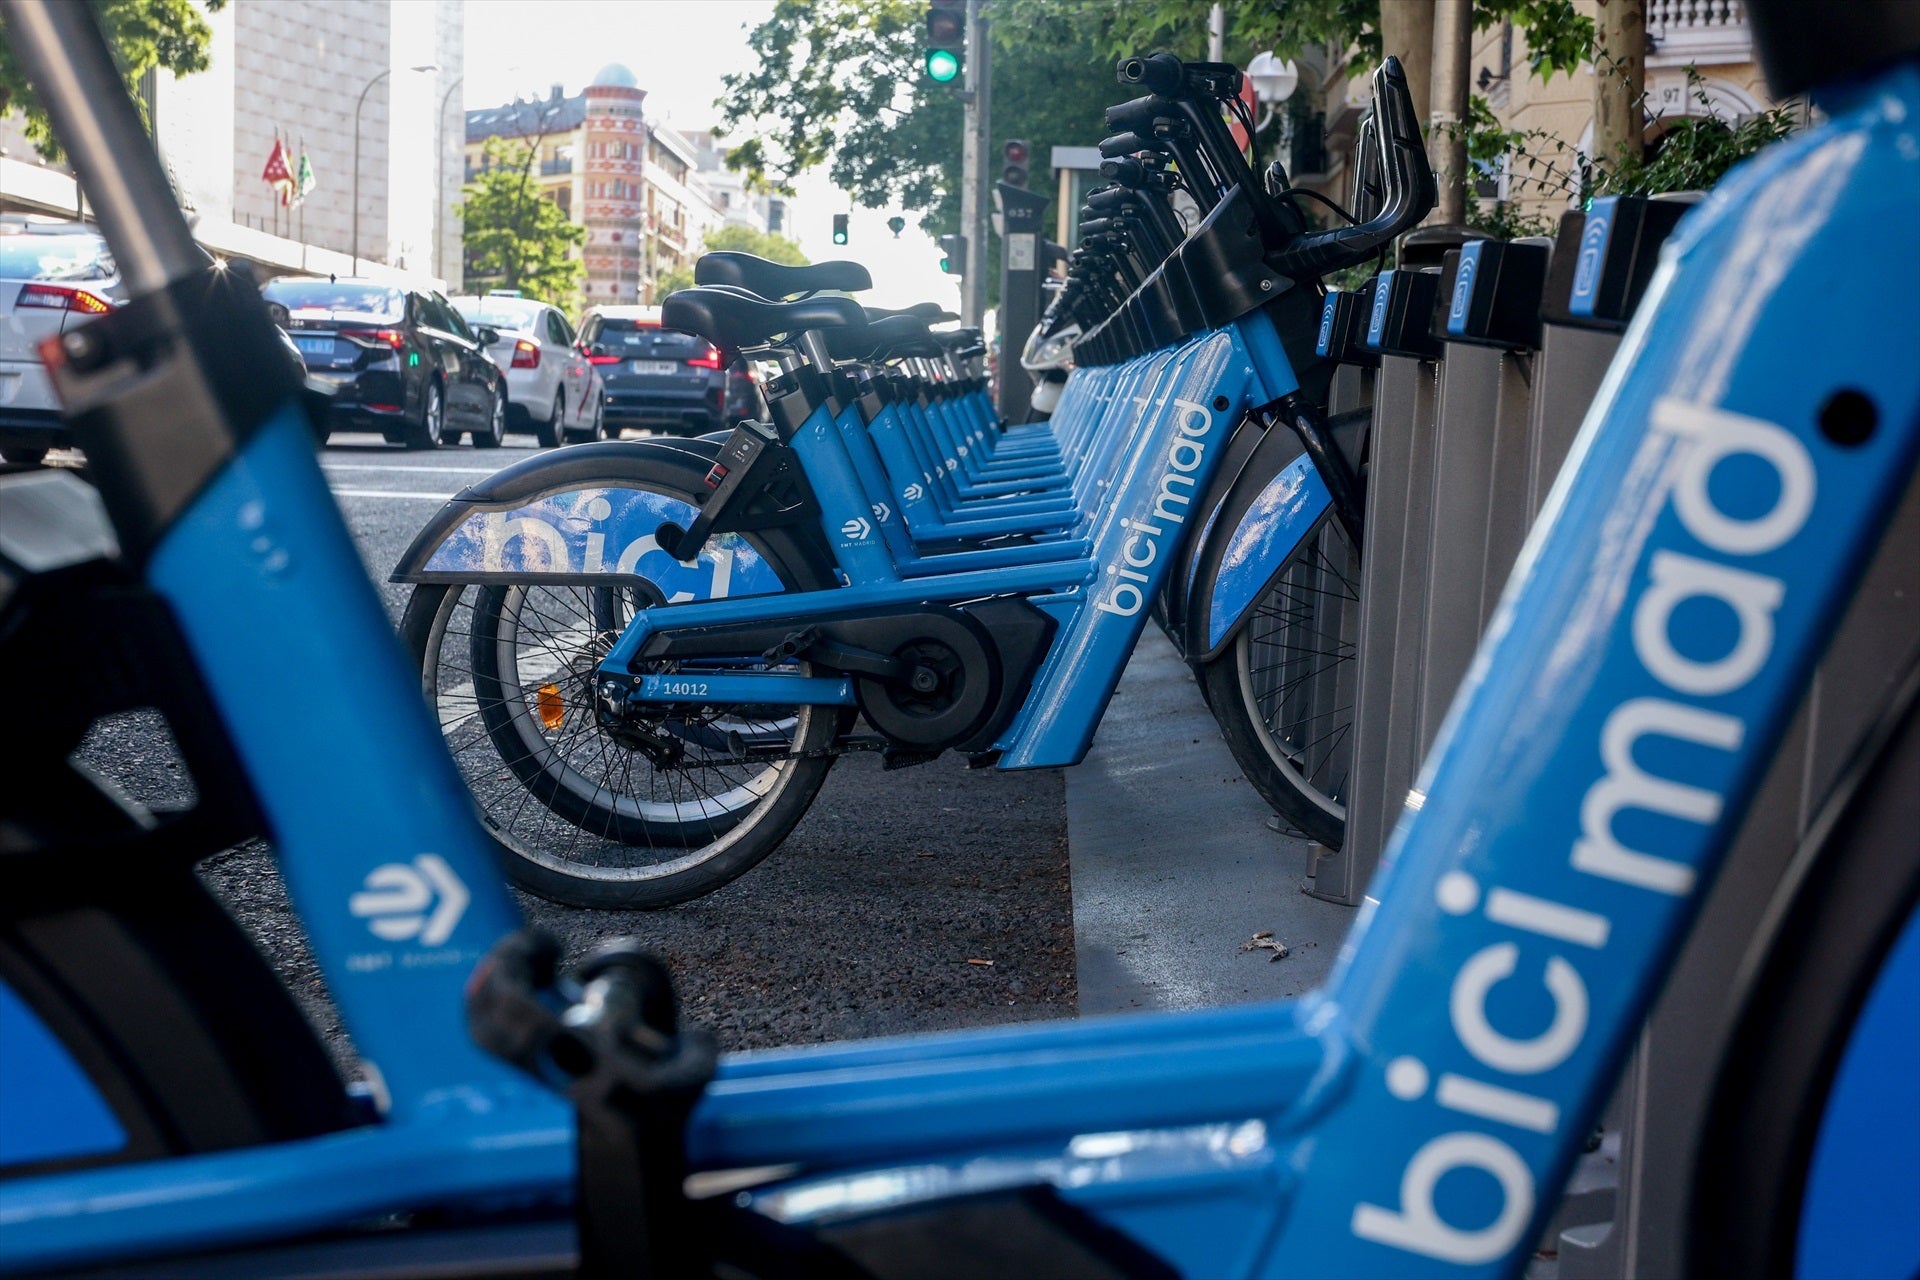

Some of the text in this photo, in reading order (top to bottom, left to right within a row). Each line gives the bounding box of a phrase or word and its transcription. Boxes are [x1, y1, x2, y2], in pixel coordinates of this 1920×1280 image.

[1663, 87, 1679, 103] 97
[1098, 398, 1212, 617] bici mad
[663, 682, 708, 696] 14012
[1351, 398, 1817, 1266] bici mad
